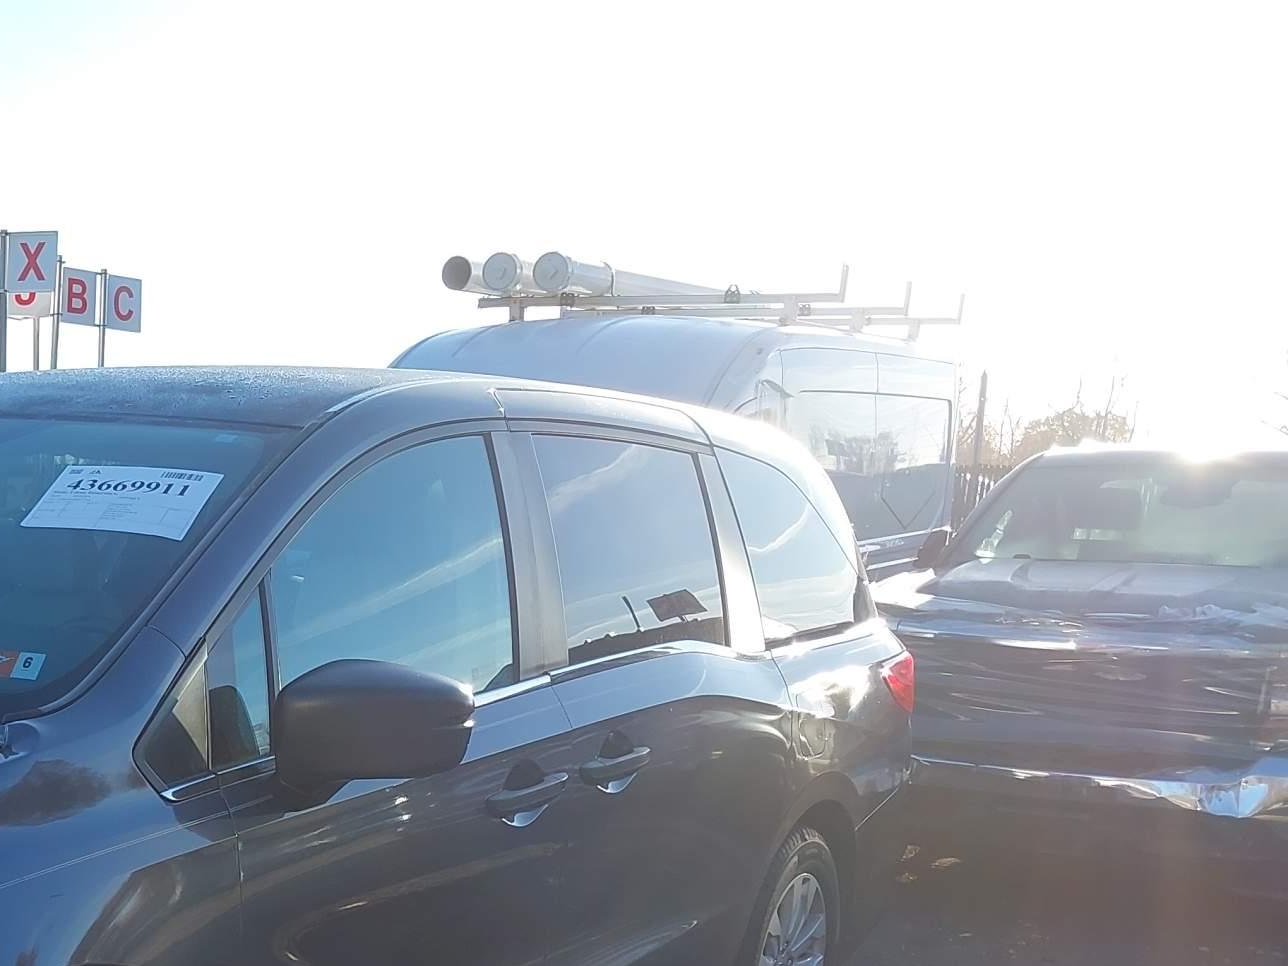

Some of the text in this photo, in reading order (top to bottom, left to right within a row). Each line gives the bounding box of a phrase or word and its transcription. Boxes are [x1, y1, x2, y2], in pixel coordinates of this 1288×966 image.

[18, 242, 46, 281] X
[67, 278, 88, 315] B
[113, 286, 134, 322] C
[67, 479, 191, 497] 43669911
[22, 657, 34, 669] 6
